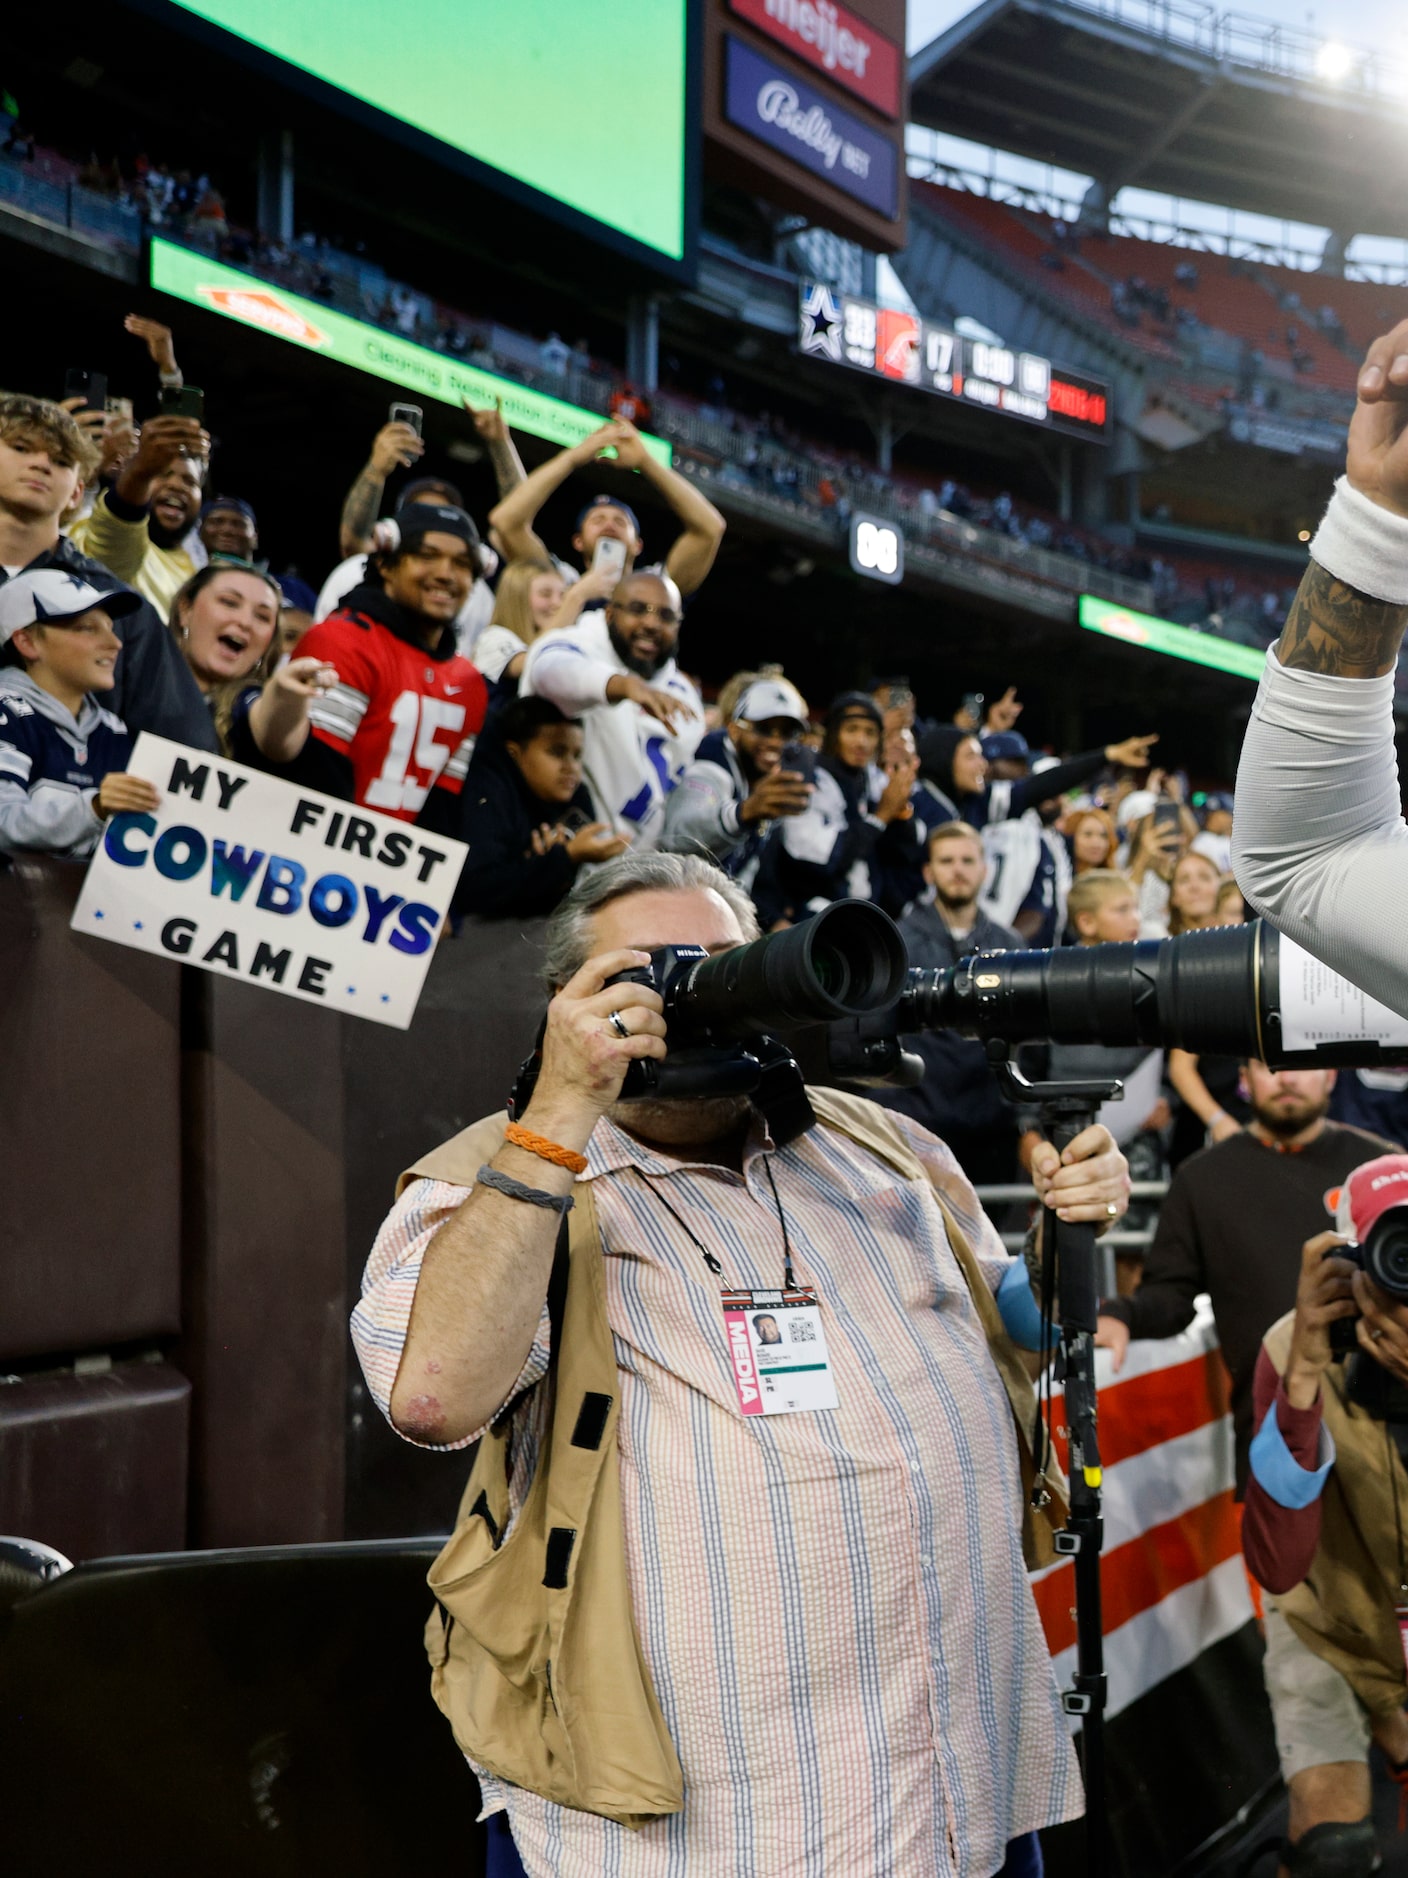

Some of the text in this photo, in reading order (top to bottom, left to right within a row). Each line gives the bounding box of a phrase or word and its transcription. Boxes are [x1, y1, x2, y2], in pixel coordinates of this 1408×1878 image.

[757, 80, 843, 169] Bally
[450, 375, 541, 422] Restortion
[364, 690, 466, 813] 15
[167, 757, 447, 883] MY FIRST
[104, 812, 441, 956] COWBOYS
[160, 917, 334, 996] GAME
[676, 949, 707, 957] Nikon
[727, 1321, 758, 1405] MEDIA
